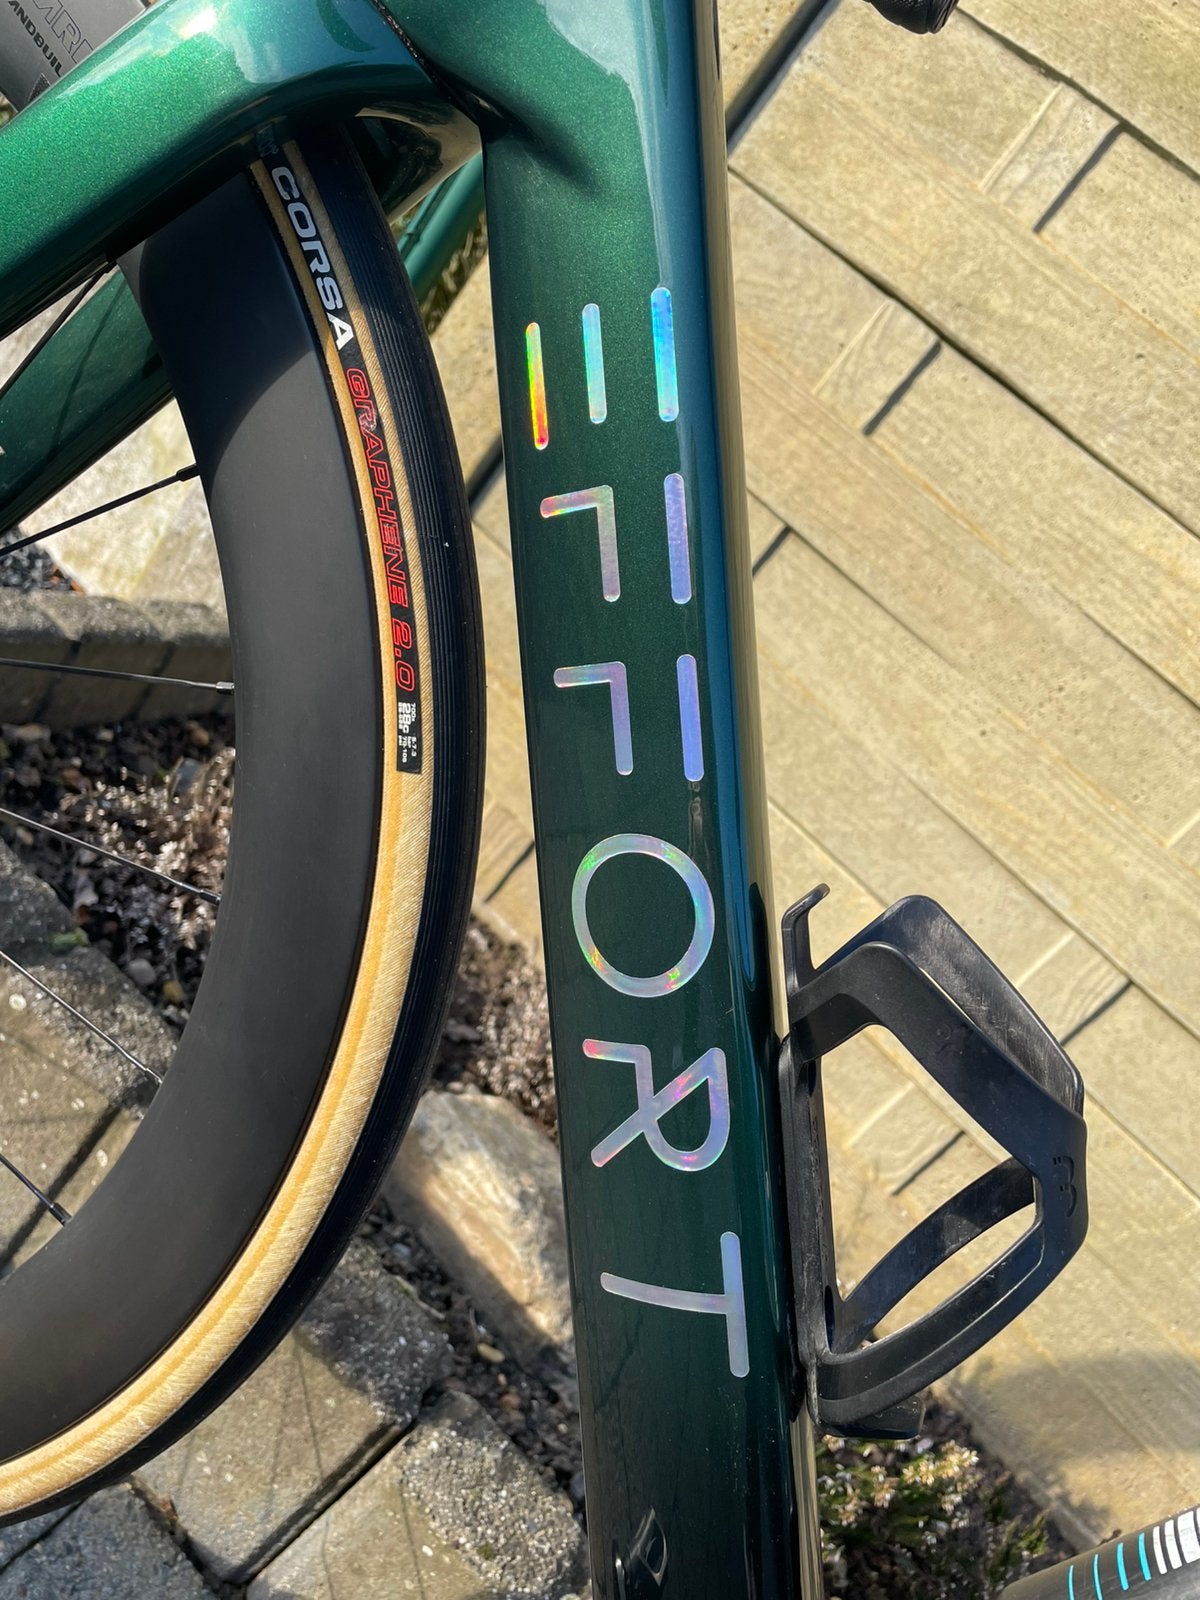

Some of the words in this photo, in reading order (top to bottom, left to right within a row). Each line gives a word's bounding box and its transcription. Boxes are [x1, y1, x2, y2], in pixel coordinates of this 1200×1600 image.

[271, 166, 355, 350] CORSA
[345, 367, 410, 605] GRAPHENE
[391, 616, 415, 692] 2.0
[525, 287, 751, 1378] EFFORT
